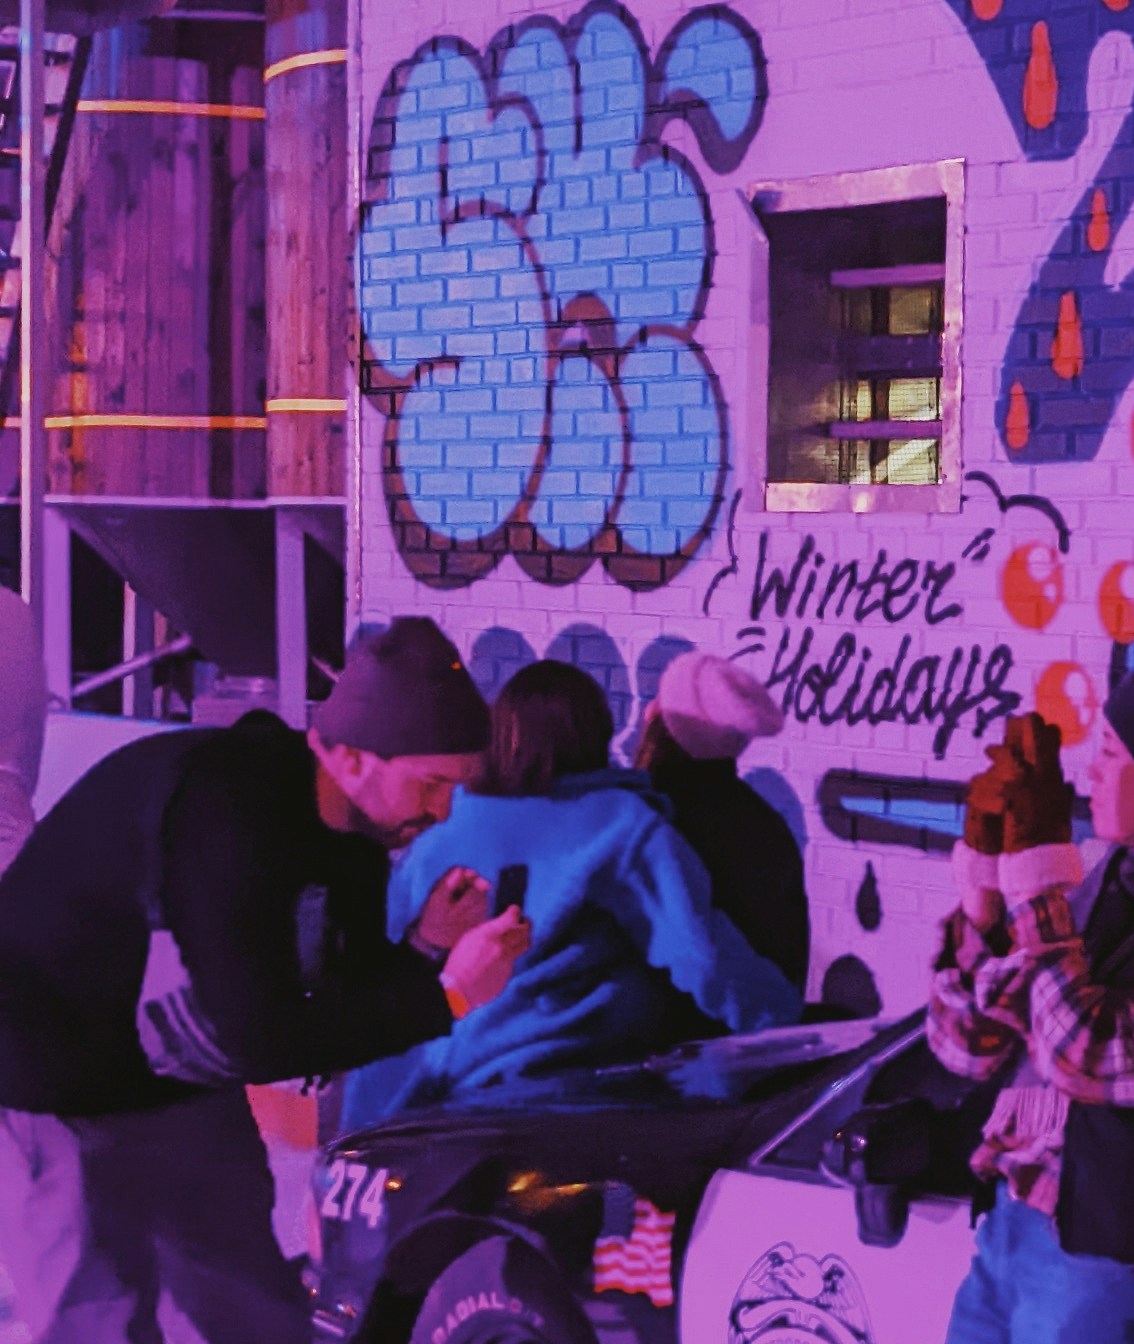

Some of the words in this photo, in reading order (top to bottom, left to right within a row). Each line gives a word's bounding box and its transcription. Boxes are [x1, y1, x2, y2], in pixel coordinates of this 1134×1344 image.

[751, 531, 963, 624] Winter
[767, 626, 1021, 760] Holidays
[321, 1159, 388, 1228] 274
